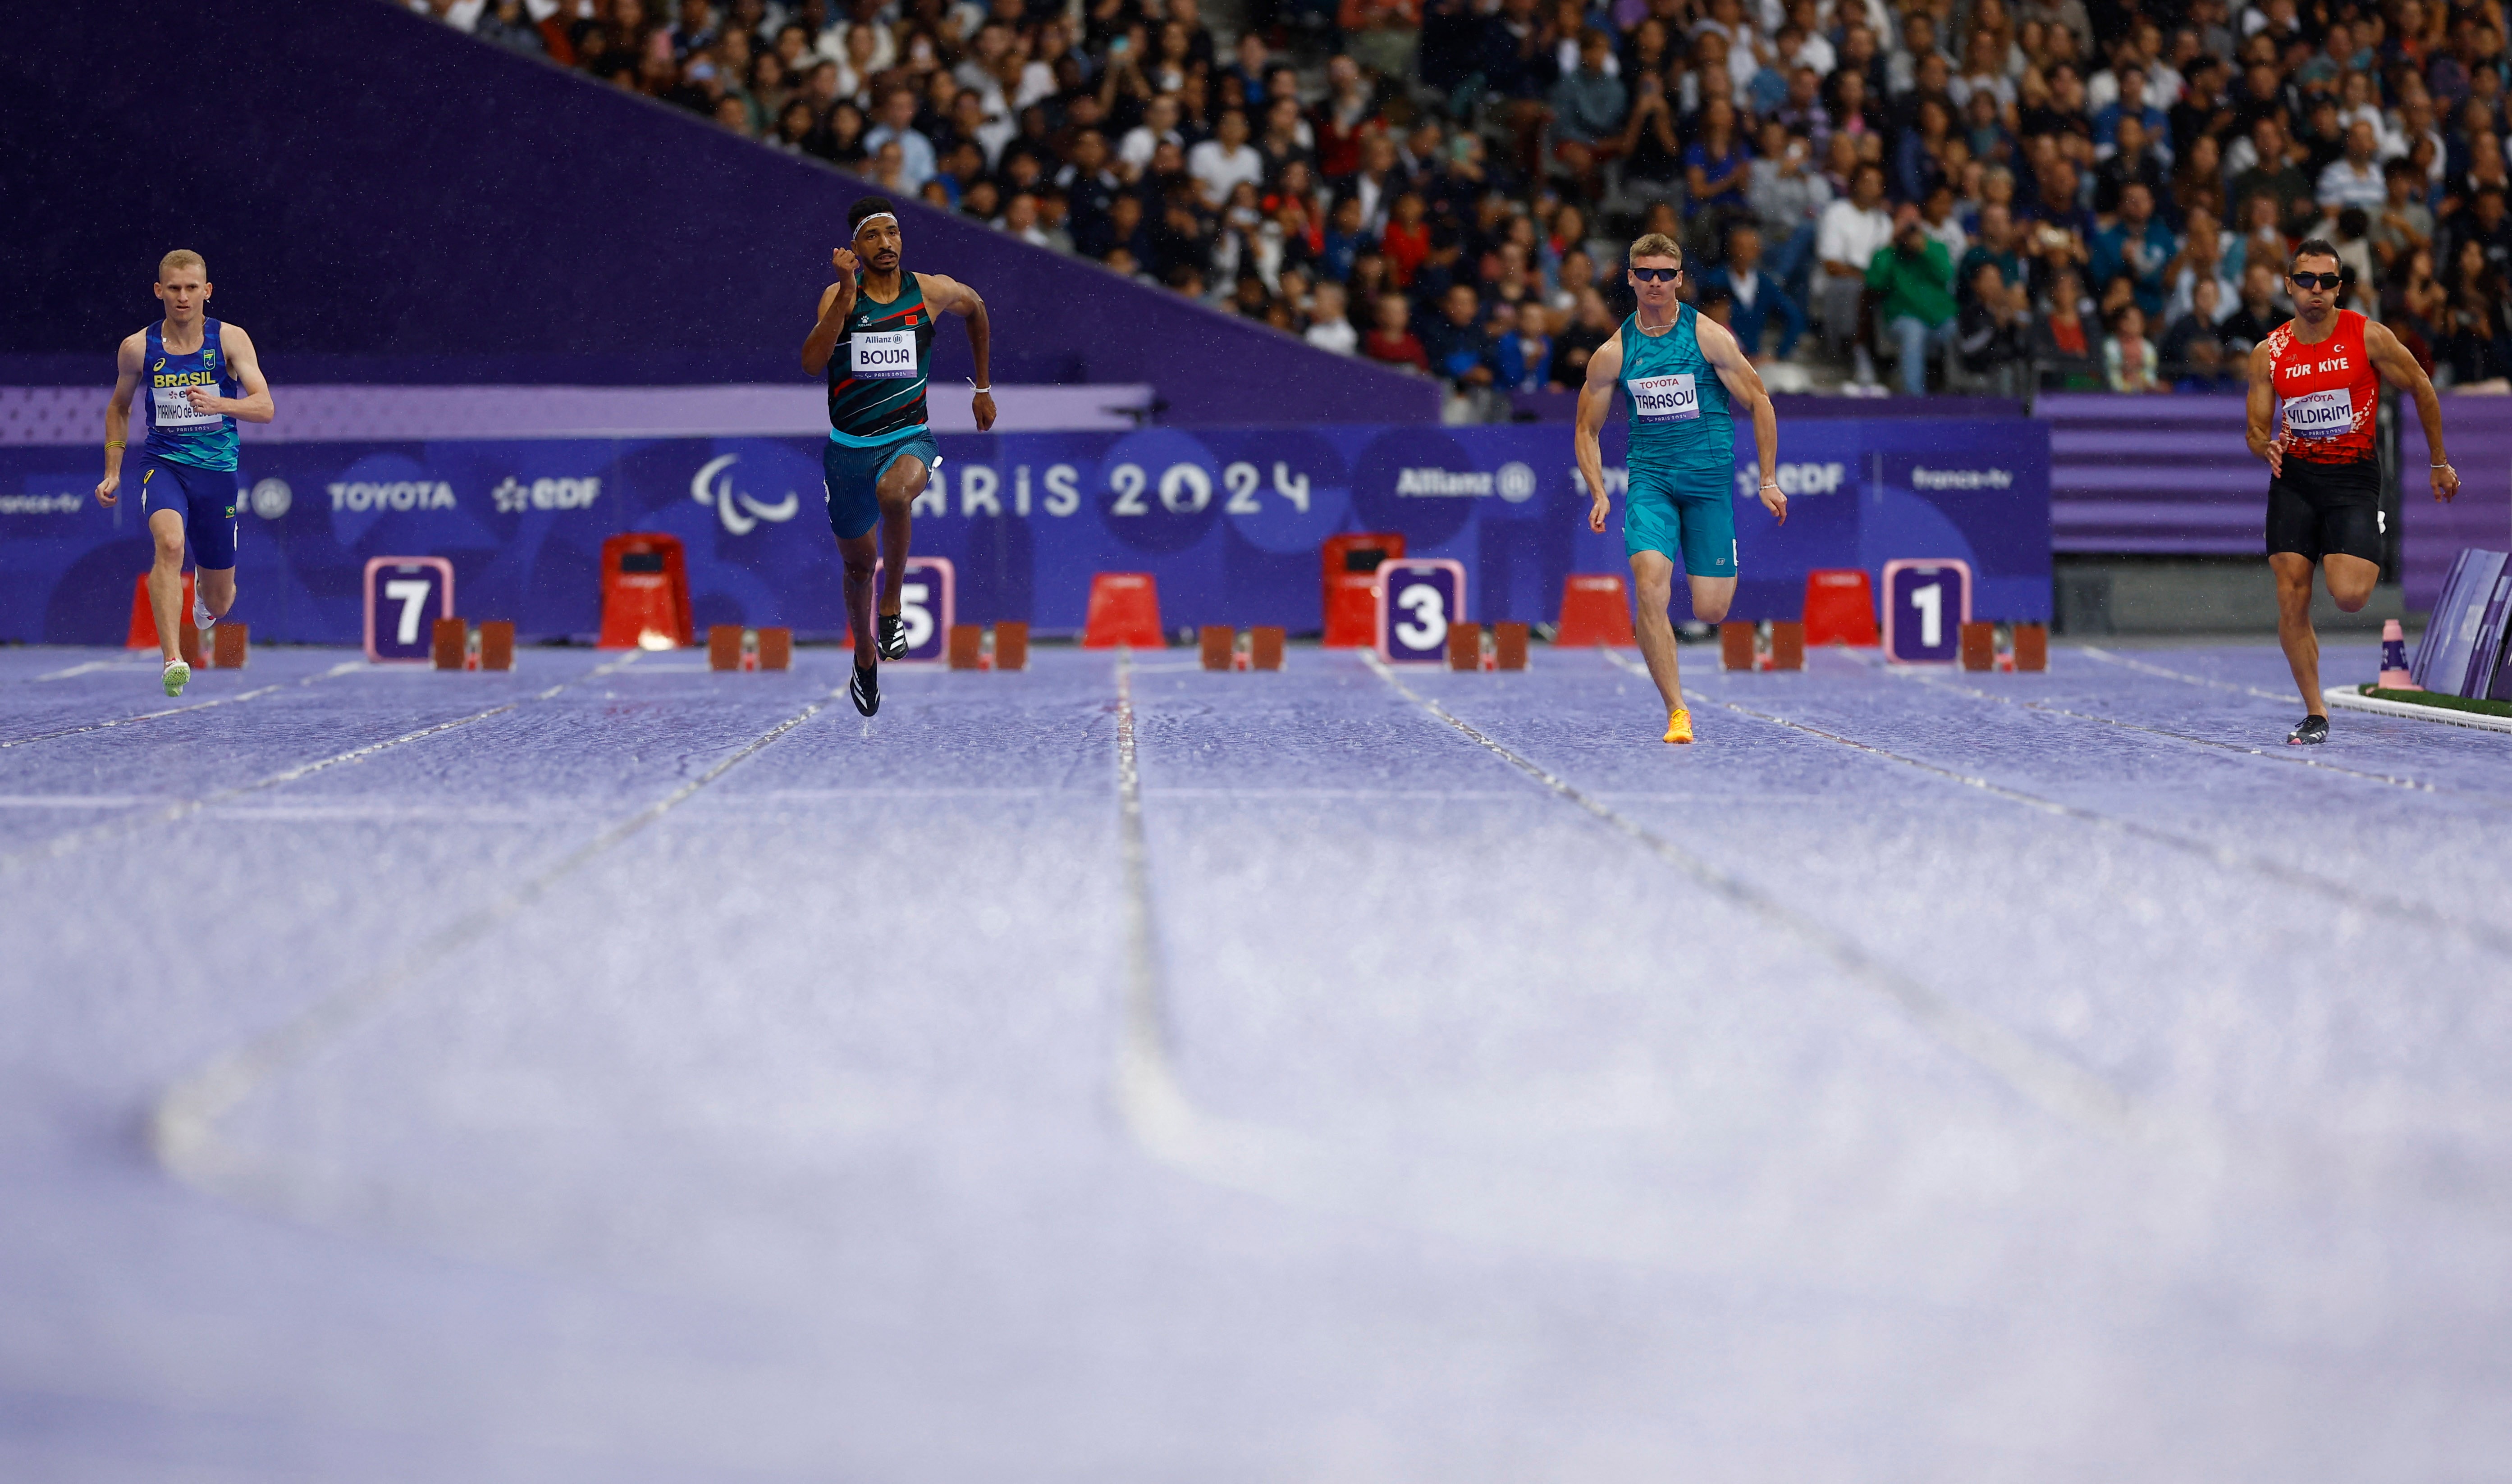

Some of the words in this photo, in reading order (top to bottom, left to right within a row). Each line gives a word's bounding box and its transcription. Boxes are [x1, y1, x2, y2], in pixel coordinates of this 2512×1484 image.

[860, 349, 909, 365] BOUJA
[2285, 363, 2311, 379] TÜR
[2318, 357, 2349, 373] KİYE
[154, 371, 216, 388] BRASIL
[1639, 378, 1679, 389] TOYOTA
[1635, 389, 1694, 409] TARASOV
[157, 405, 183, 419] MARINHO
[183, 404, 192, 418] de
[2288, 404, 2351, 424] YILDIRIM
[329, 481, 456, 511] TOYOTA
[1109, 461, 1310, 516] 2024
[385, 580, 431, 645] 7
[901, 583, 933, 650] 5
[1395, 584, 1448, 651] 3
[1911, 582, 1941, 647] 1
